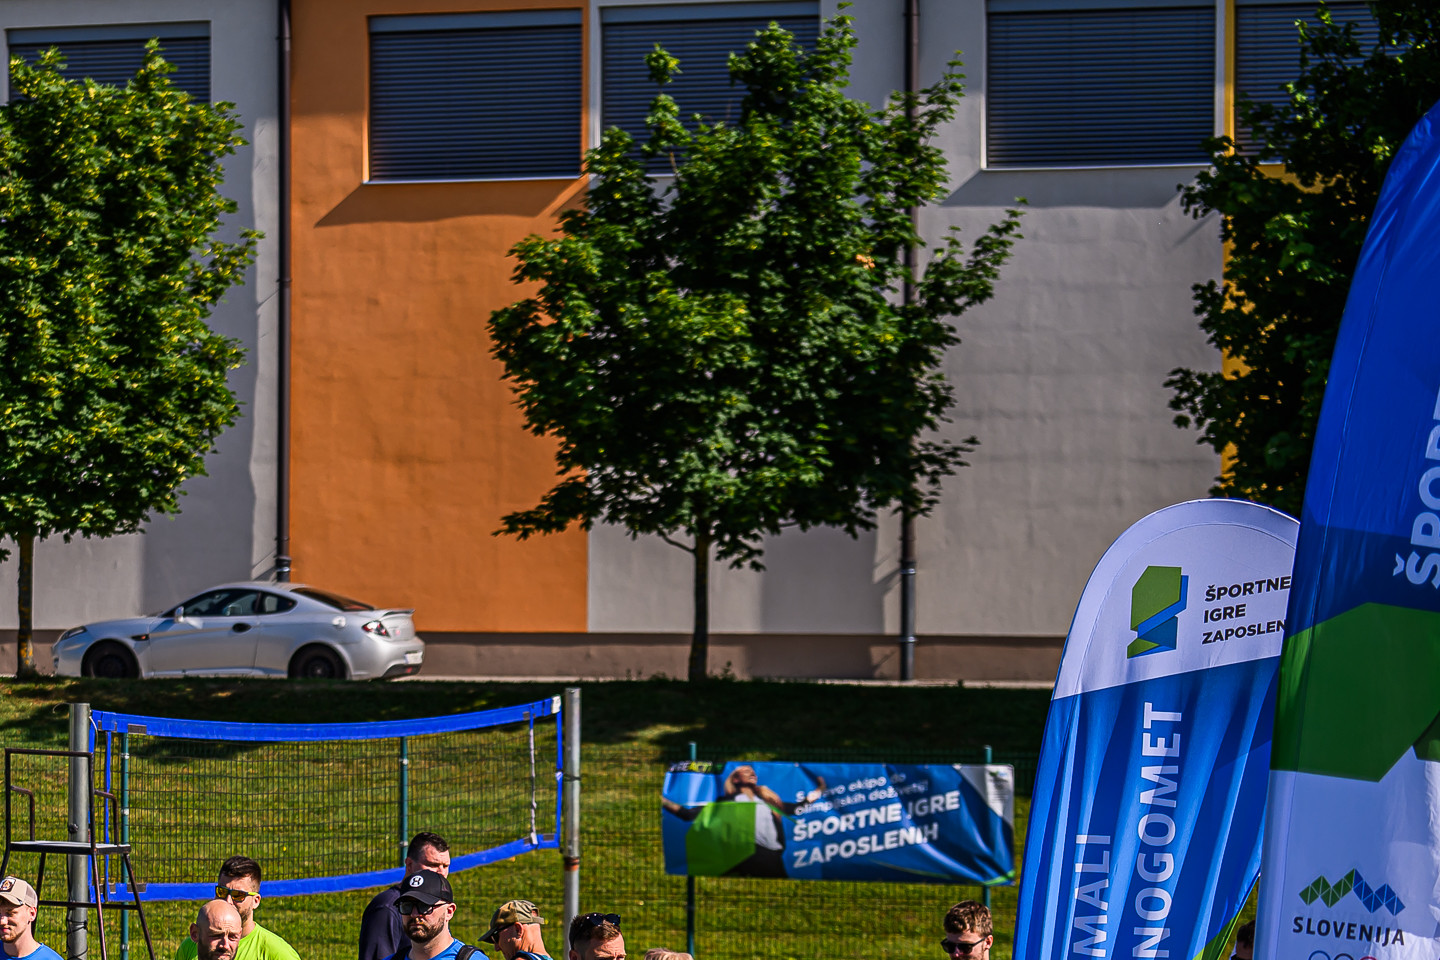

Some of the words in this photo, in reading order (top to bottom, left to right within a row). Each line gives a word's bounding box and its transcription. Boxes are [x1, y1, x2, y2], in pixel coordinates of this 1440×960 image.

[1204, 575, 1292, 602] ŠPORTNE
[1203, 603, 1247, 624] IGRE
[1201, 619, 1286, 645] ZAPOSLEN
[793, 802, 902, 842] ŠPORTNE
[907, 790, 961, 819] IGRE
[1132, 701, 1183, 959] NOGOMET
[1073, 834, 1111, 958] MALI
[1292, 916, 1405, 947] SLOVENIJA
